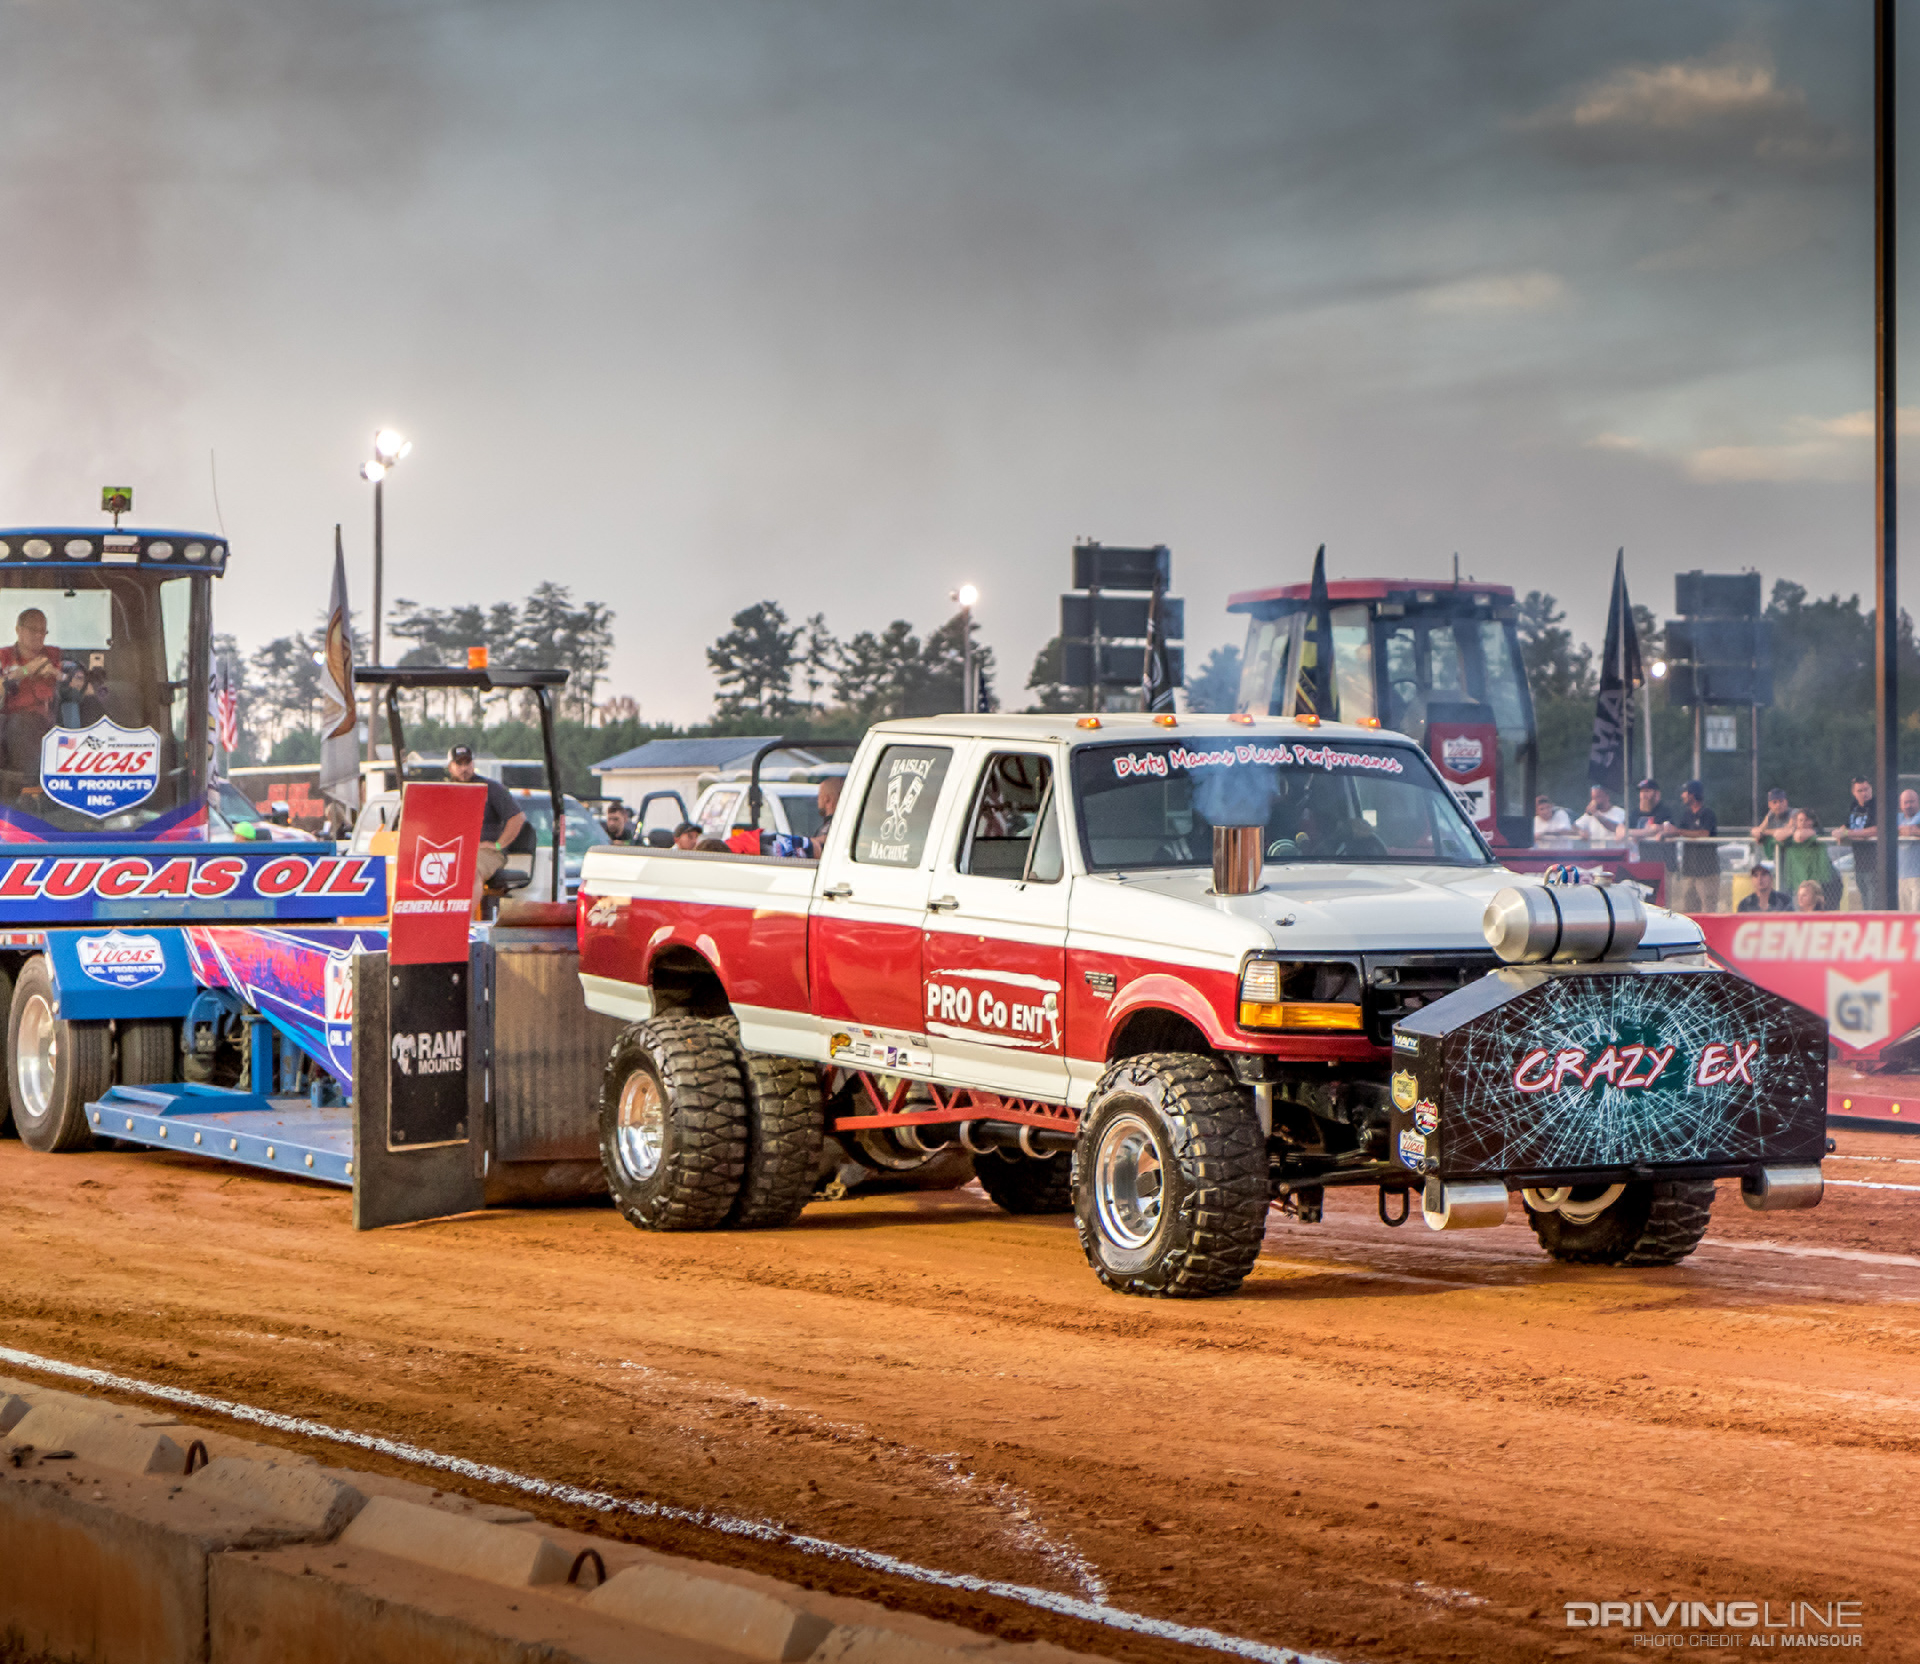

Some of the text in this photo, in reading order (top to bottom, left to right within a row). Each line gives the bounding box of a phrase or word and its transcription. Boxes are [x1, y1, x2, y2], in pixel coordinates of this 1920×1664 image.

[57, 751, 152, 773] LUCAS
[1114, 744, 1403, 777] Dirty Manns Diesel Performance
[48, 779, 153, 791] OIL PRODUCTS
[87, 795, 115, 806] INC.
[869, 840, 910, 862] MACHINE
[0, 856, 374, 899] LUCAS OIL
[420, 852, 456, 885] GT
[393, 899, 471, 914] GENERAL TIRE
[1732, 921, 1906, 961] GENERAL
[92, 950, 155, 963] LUCAS
[107, 965, 161, 974] PRODUCTS
[927, 982, 973, 1023] PRO
[1011, 1003, 1047, 1034] ENT
[1836, 990, 1881, 1031] GT
[418, 1030, 463, 1059] RAM
[418, 1057, 462, 1074] MOUNTS
[1513, 1041, 1760, 1092] CRAZY EX
[1403, 1140, 1424, 1154] LUCAS
